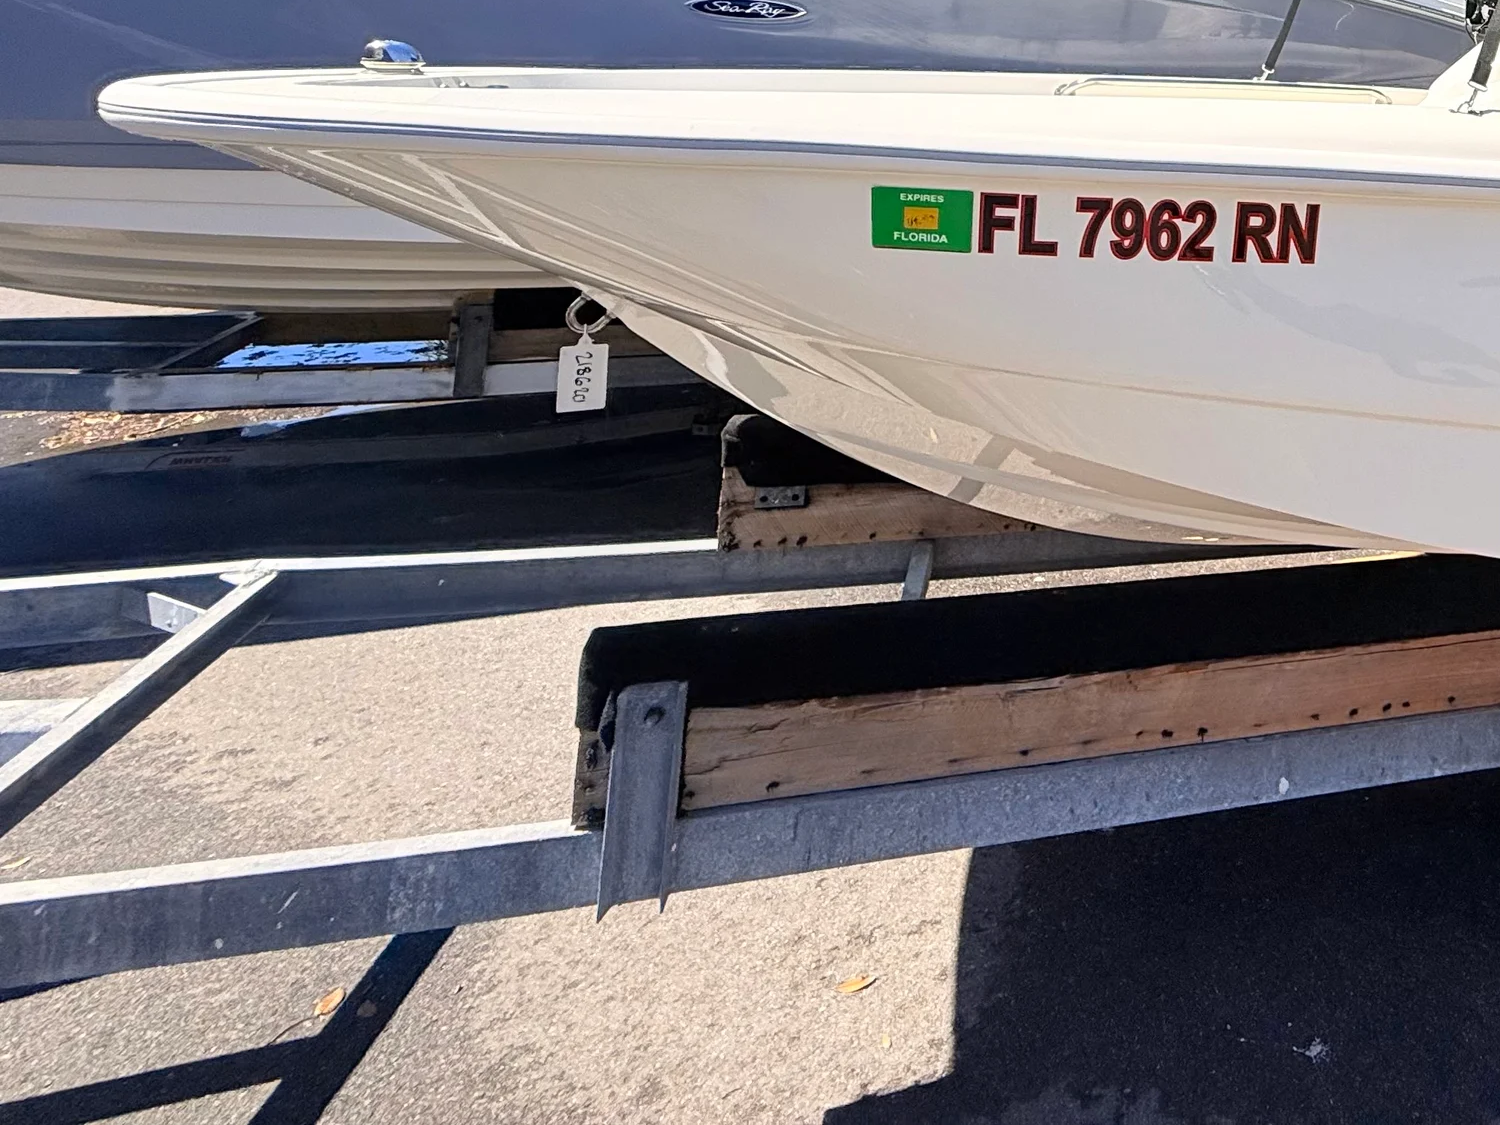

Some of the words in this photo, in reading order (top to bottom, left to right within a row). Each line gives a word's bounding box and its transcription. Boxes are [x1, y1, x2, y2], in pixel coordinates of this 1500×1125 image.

[704, 1, 739, 13] Sea
[745, 2, 786, 18] Ray
[900, 193, 944, 203] EXPIRES
[978, 192, 1059, 257] FL
[1075, 196, 1218, 262] 7962
[1231, 201, 1321, 265] RN
[894, 231, 948, 243] FLORIDA
